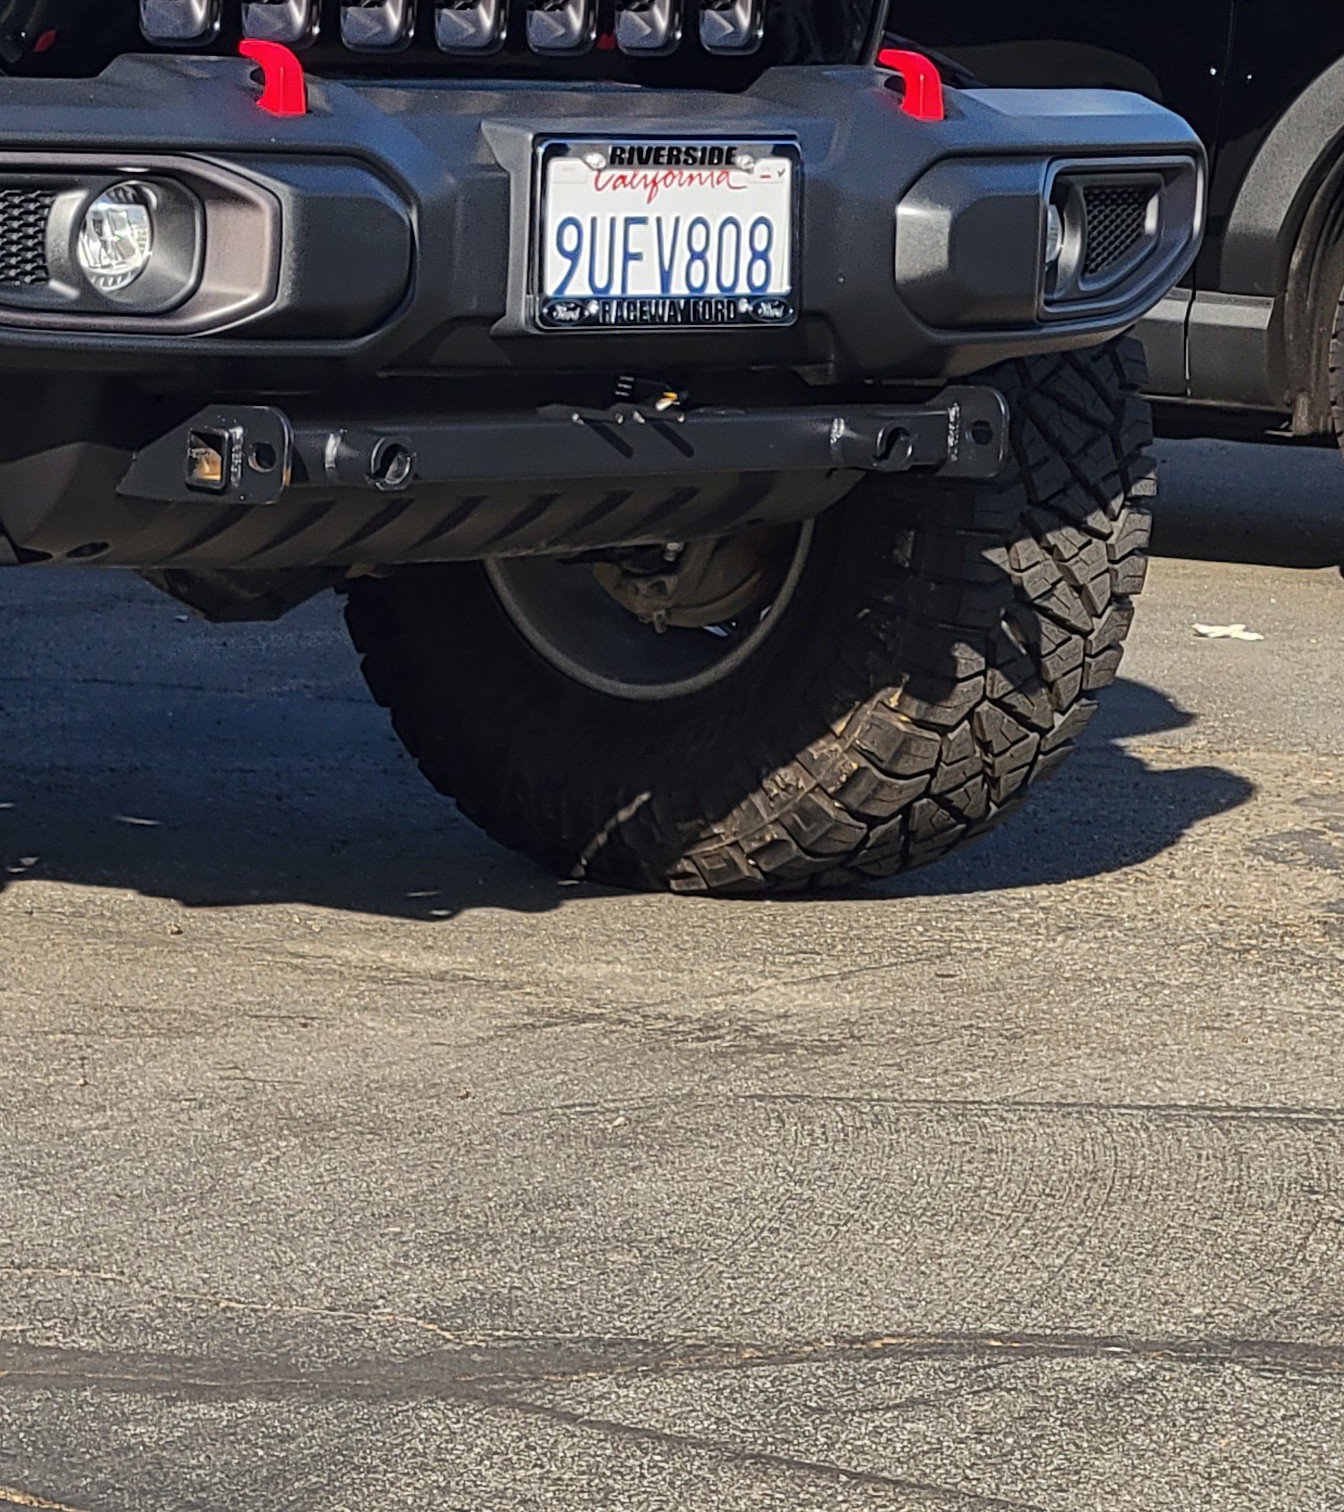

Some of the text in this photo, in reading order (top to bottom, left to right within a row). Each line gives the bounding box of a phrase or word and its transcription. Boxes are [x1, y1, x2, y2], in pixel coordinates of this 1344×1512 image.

[609, 146, 737, 167] RIVERSIDE
[553, 215, 773, 296] 9UFV808
[691, 299, 737, 322] FORD
